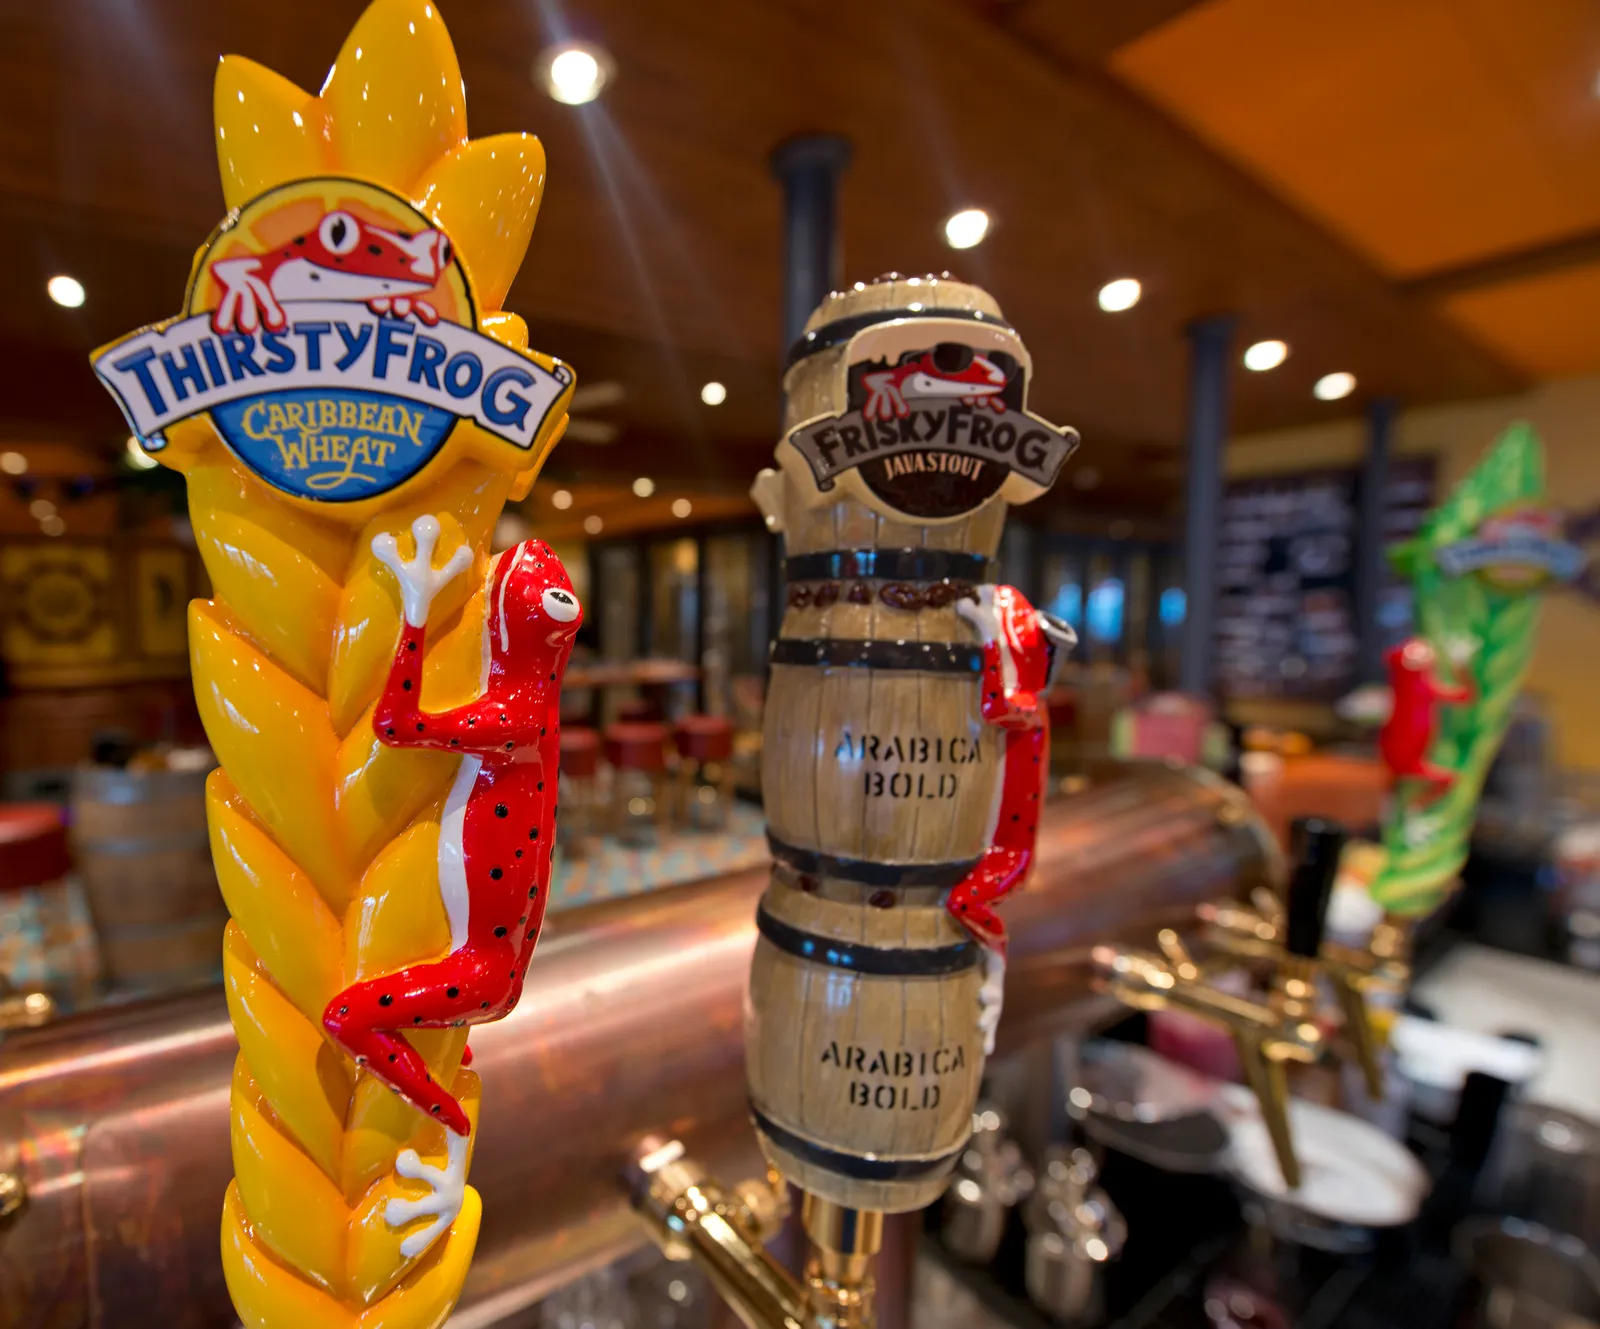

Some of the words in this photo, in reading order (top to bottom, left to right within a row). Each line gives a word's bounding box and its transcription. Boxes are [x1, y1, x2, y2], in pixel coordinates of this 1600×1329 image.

[241, 400, 427, 446] CARIBBEAN
[271, 430, 396, 489] WHEAT
[835, 732, 983, 763] ARABICA
[864, 772, 957, 799] BOLD
[820, 1041, 965, 1076] ARABICA
[850, 1082, 940, 1110] BOLD
